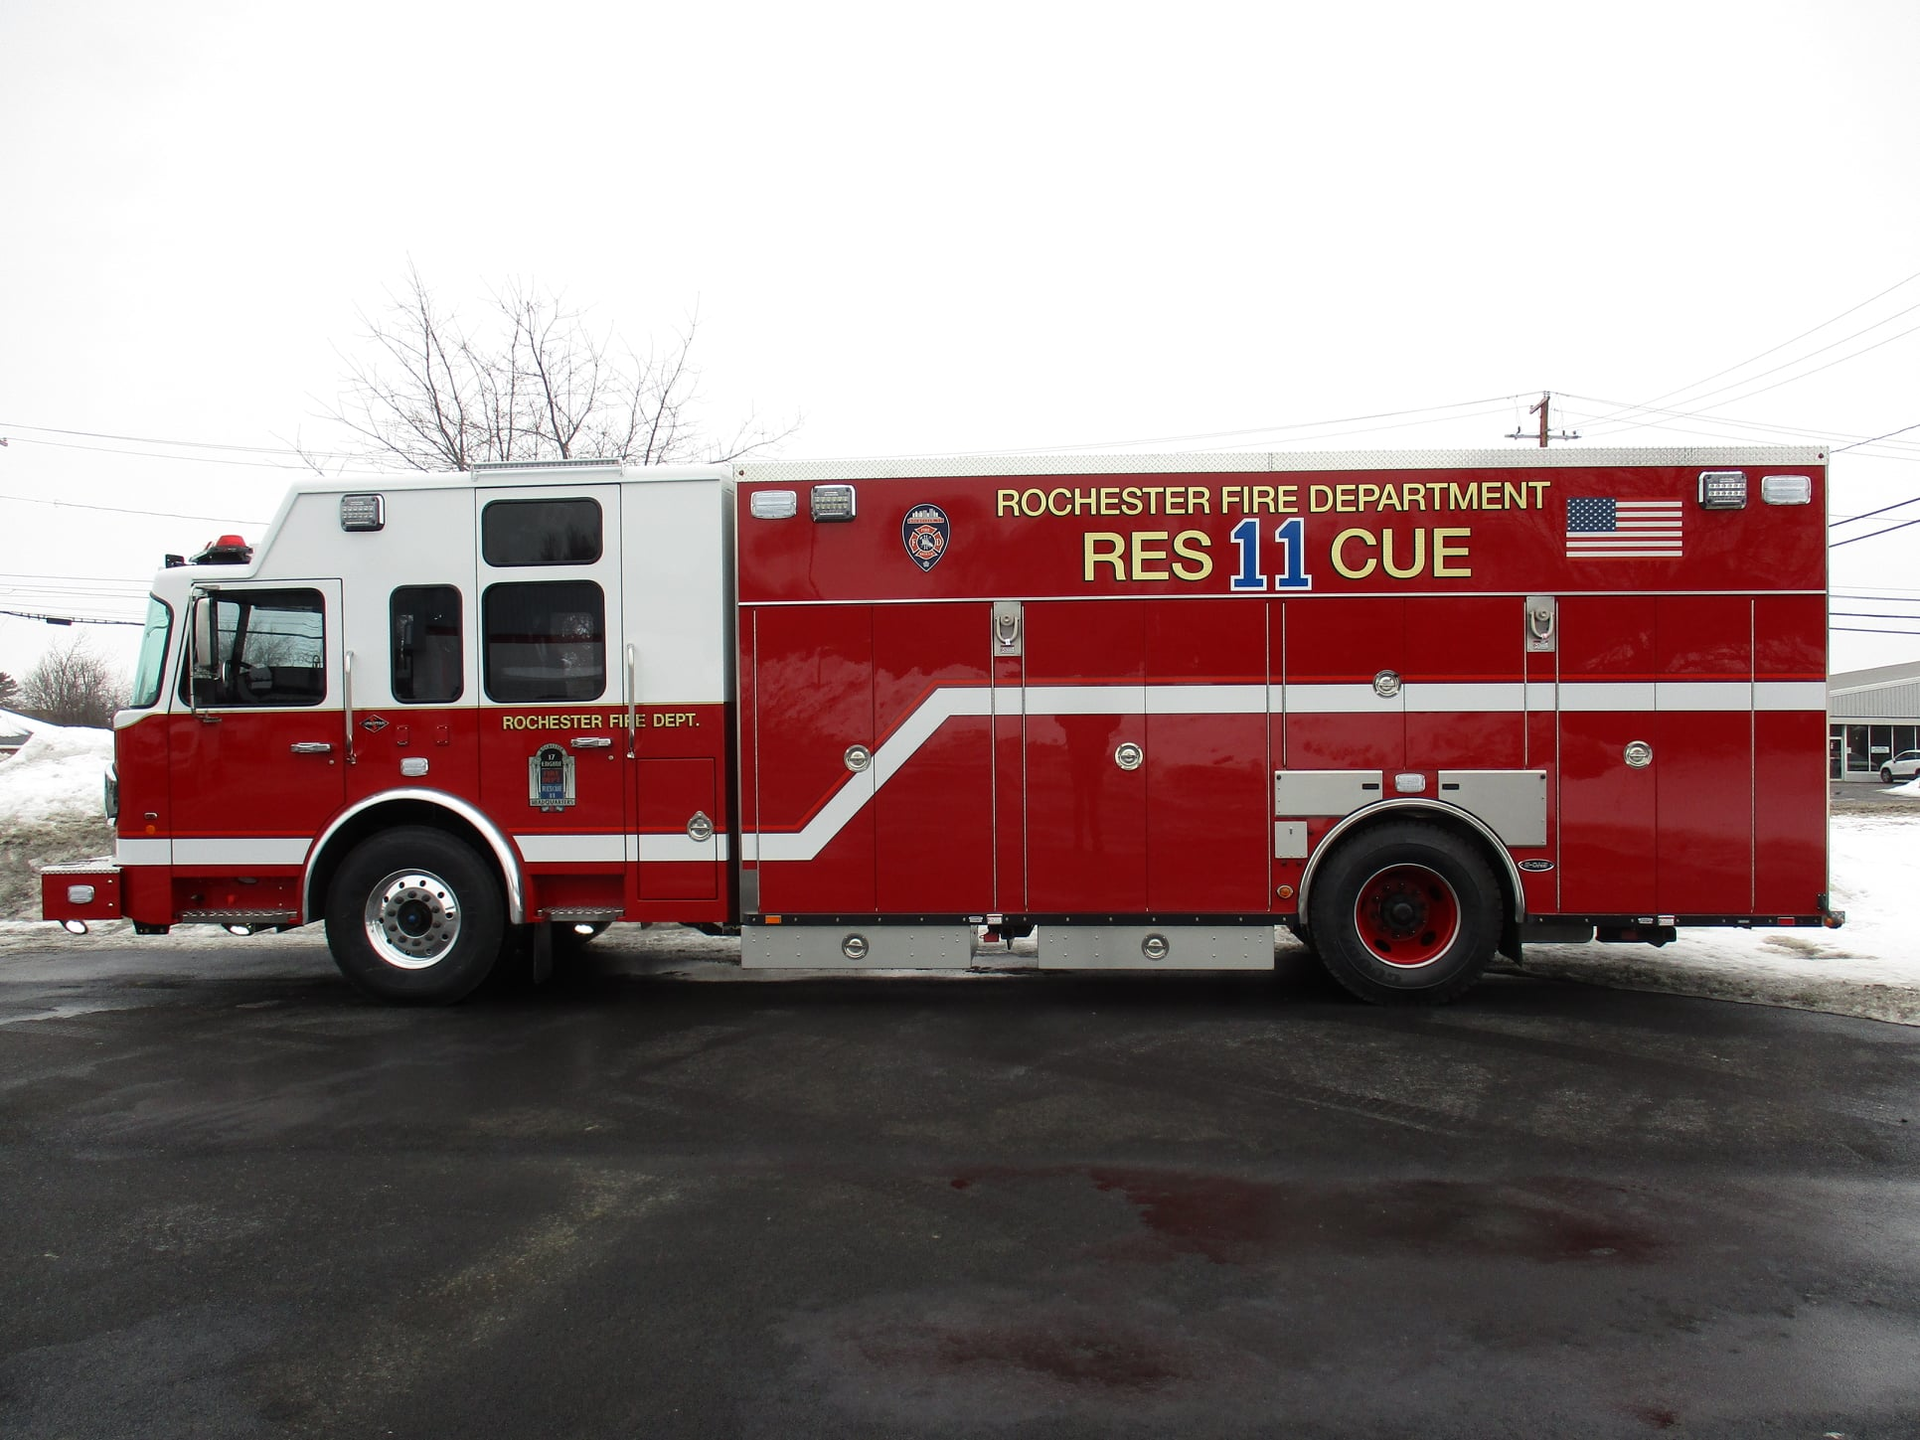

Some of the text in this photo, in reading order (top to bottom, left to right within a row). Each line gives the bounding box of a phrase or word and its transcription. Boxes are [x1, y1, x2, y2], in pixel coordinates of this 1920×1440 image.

[997, 481, 1551, 517] ROCHESTER FIRE DEPARTMENT
[1083, 516, 1472, 592] RES 11 CUE
[502, 714, 602, 730] ROCHESTER
[653, 712, 700, 728] DEPT.
